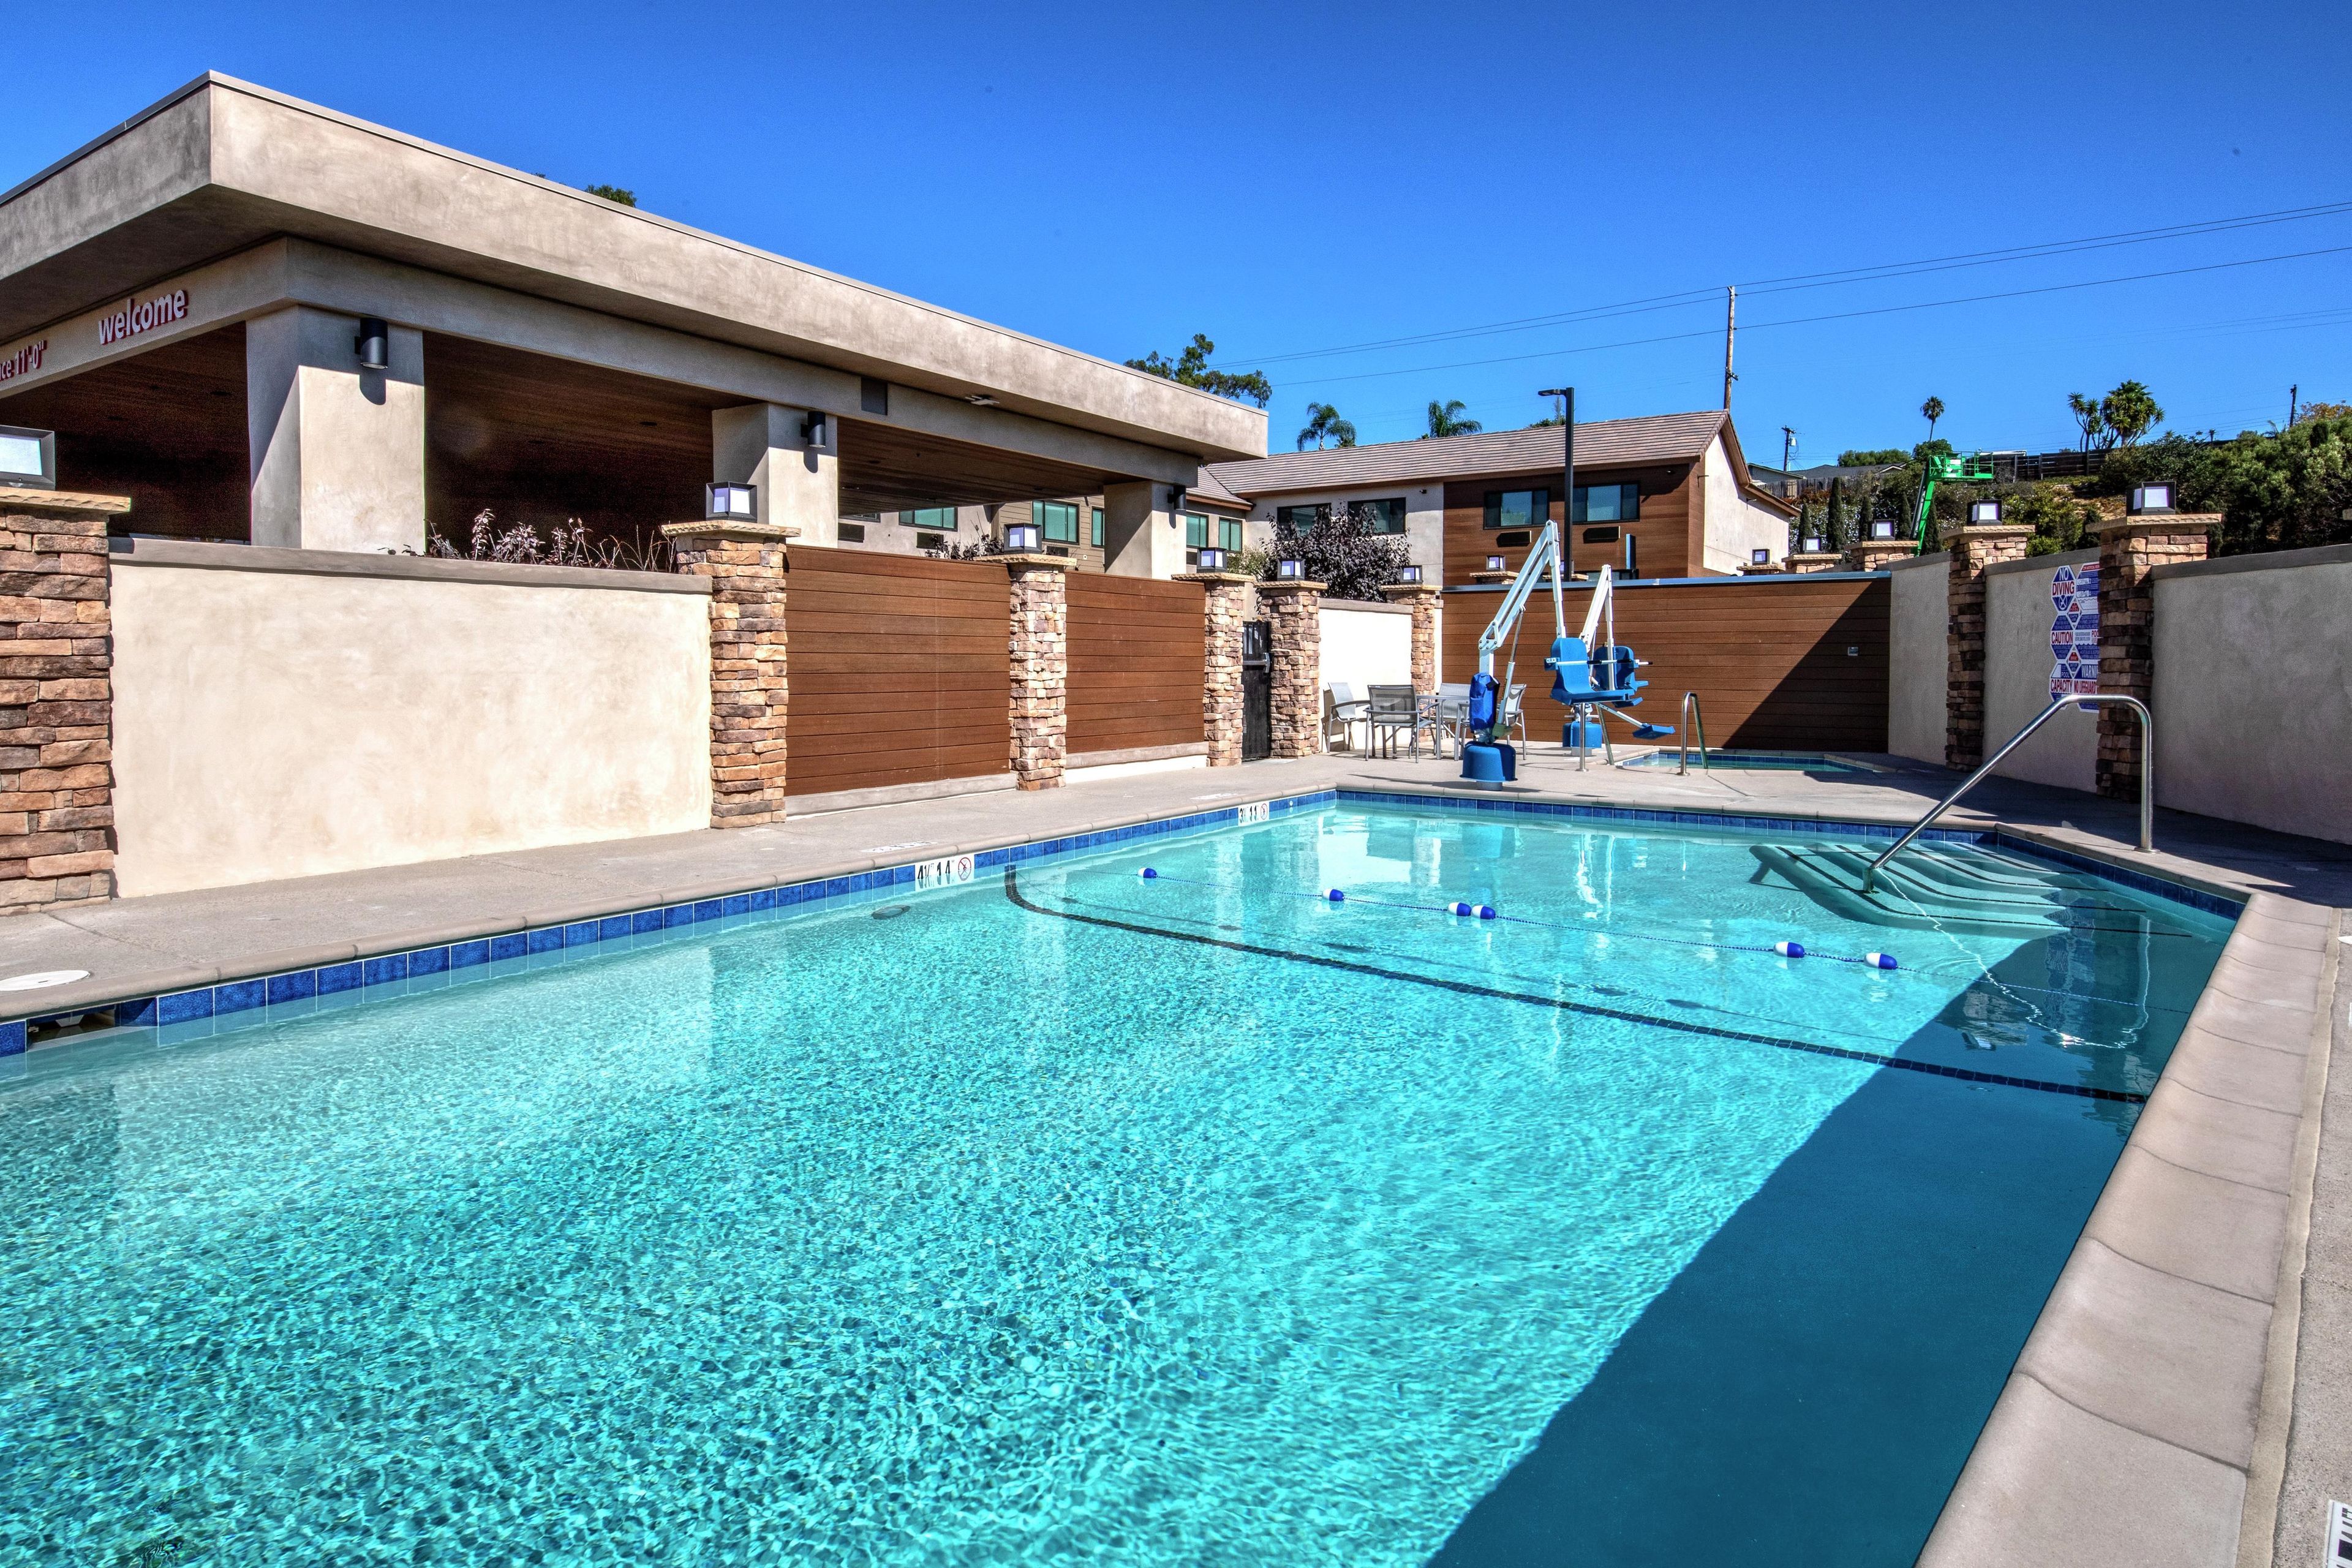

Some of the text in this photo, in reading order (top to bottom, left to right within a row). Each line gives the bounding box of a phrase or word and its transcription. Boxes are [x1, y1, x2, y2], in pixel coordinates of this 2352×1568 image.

[99, 289, 187, 344] welcome
[2059, 567, 2068, 581] NO
[2052, 581, 2075, 596] DIVING
[2051, 631, 2073, 644] CAUTION
[2082, 665, 2097, 678] WARNI
[2051, 679, 2072, 693] CAPACITY
[2079, 680, 2095, 693] LIFEGUARD
